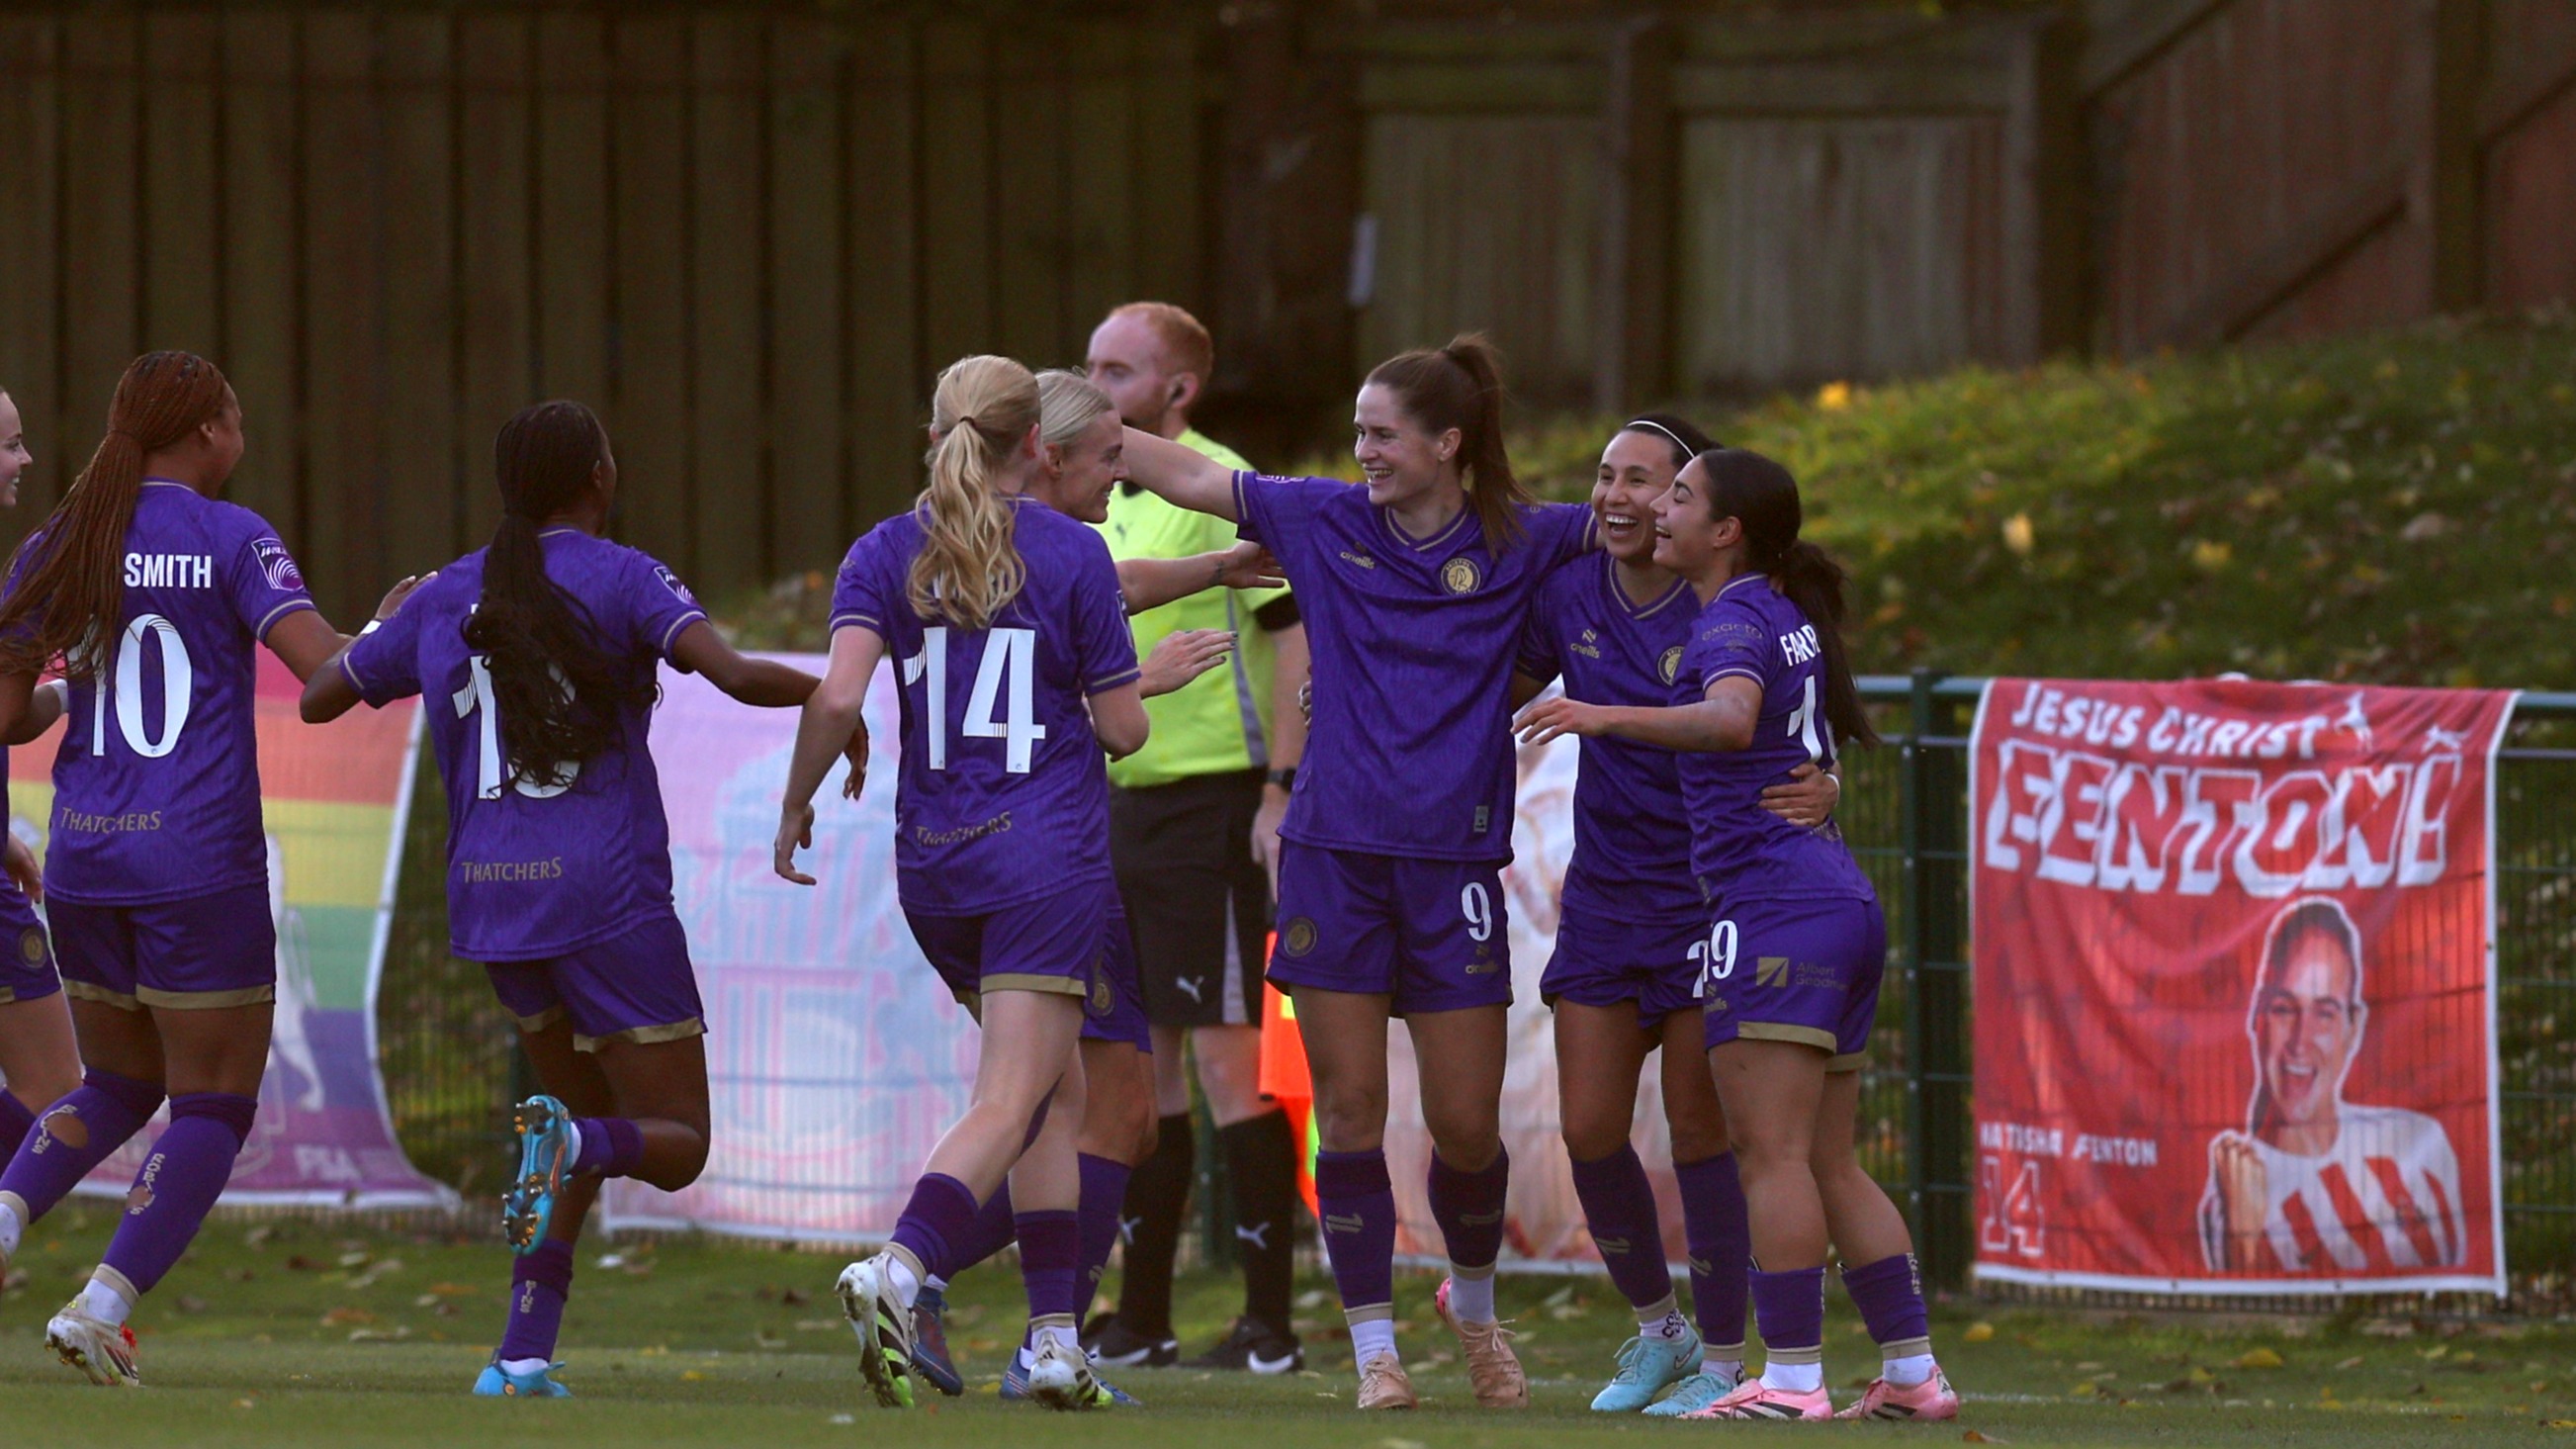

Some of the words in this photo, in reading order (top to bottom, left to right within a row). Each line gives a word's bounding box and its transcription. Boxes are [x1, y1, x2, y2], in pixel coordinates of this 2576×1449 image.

[124, 553, 212, 588] SMITH
[66, 613, 192, 758] 10
[903, 626, 1046, 773] 14
[2011, 681, 2146, 748] JESUS
[2147, 705, 2330, 759] CHRIST
[461, 857, 563, 883] THATCHERS
[1461, 881, 1492, 942] 9
[2072, 1132, 2158, 1166] FENTON
[1982, 1155, 2045, 1257] 14
